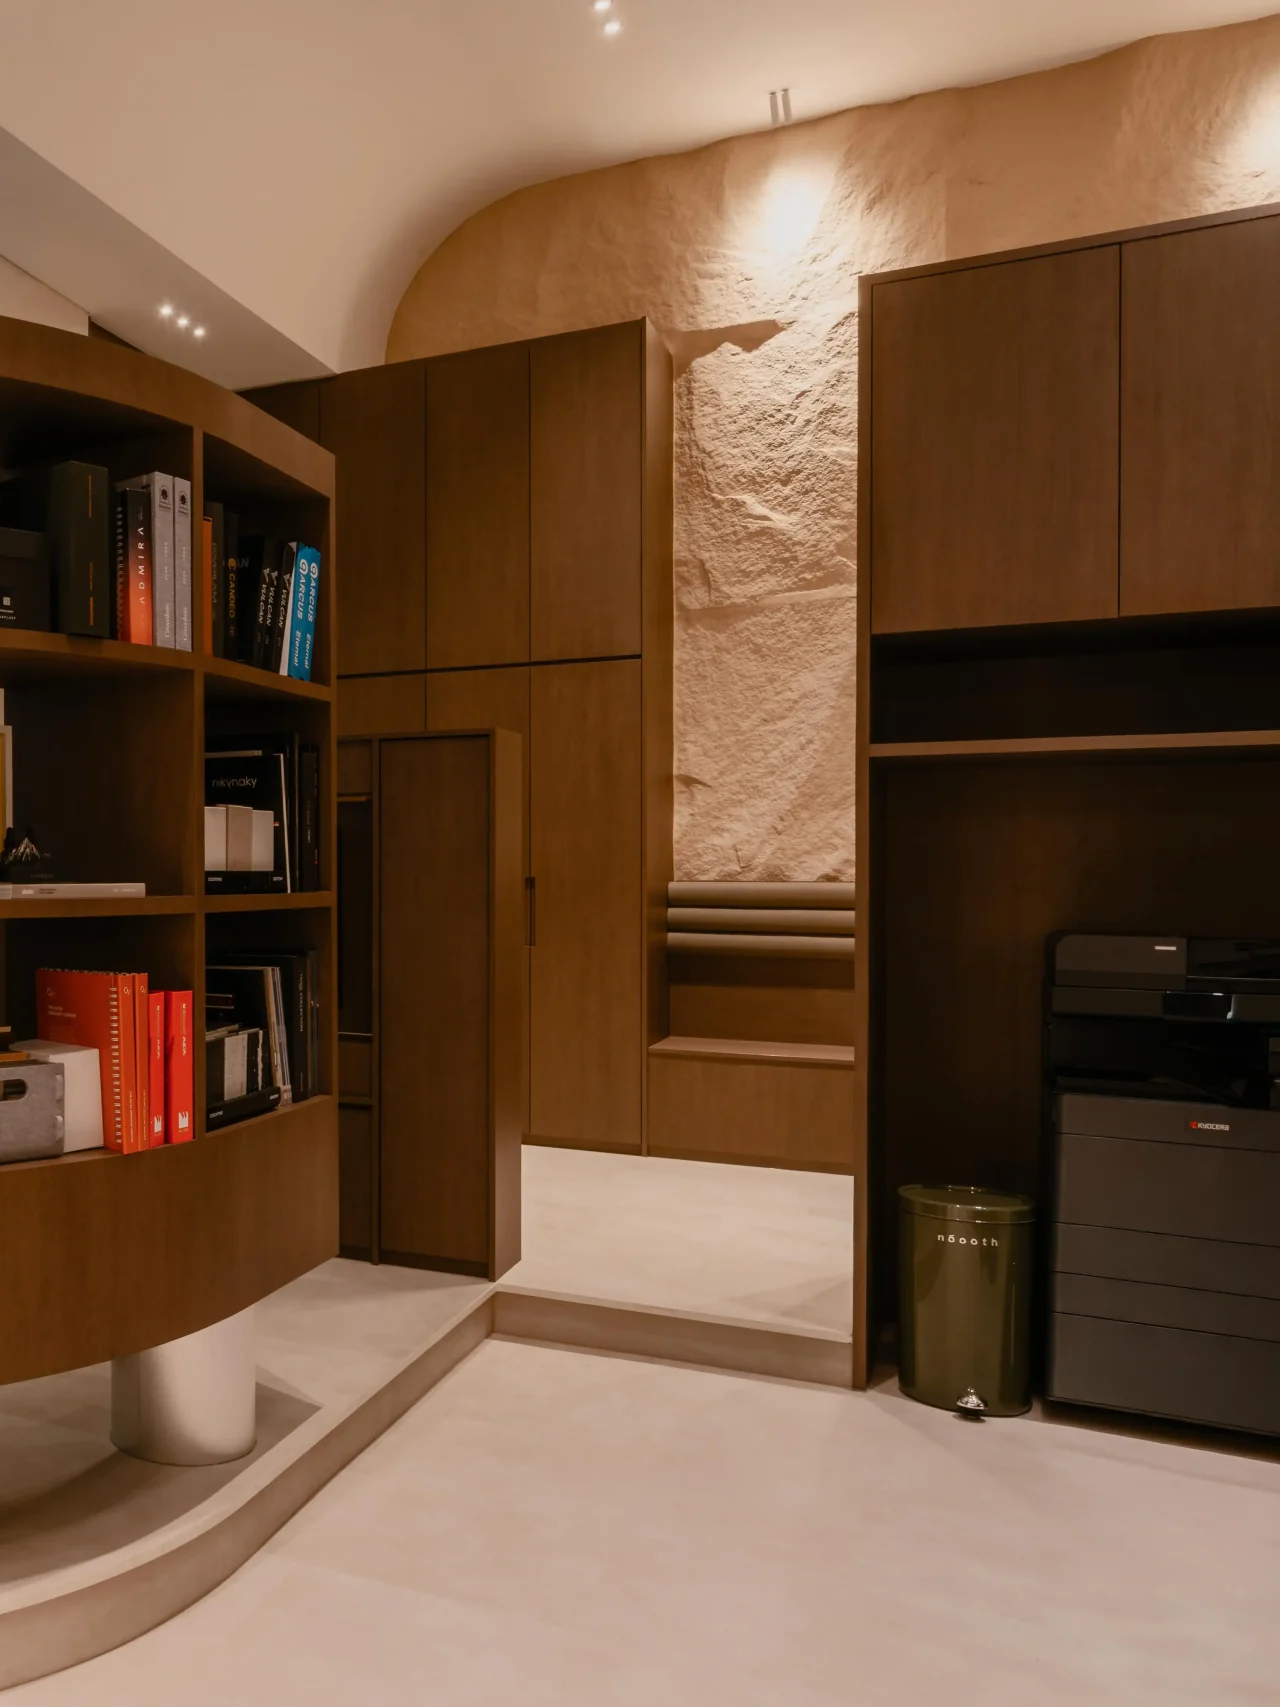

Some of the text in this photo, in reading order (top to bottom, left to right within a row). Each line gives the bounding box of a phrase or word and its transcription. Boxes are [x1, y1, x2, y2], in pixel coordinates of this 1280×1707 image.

[258, 584, 267, 624] VULCAN
[266, 587, 275, 626] VULCAN
[278, 589, 288, 628] VULCAN
[1198, 1122, 1230, 1131] KYOCERA
